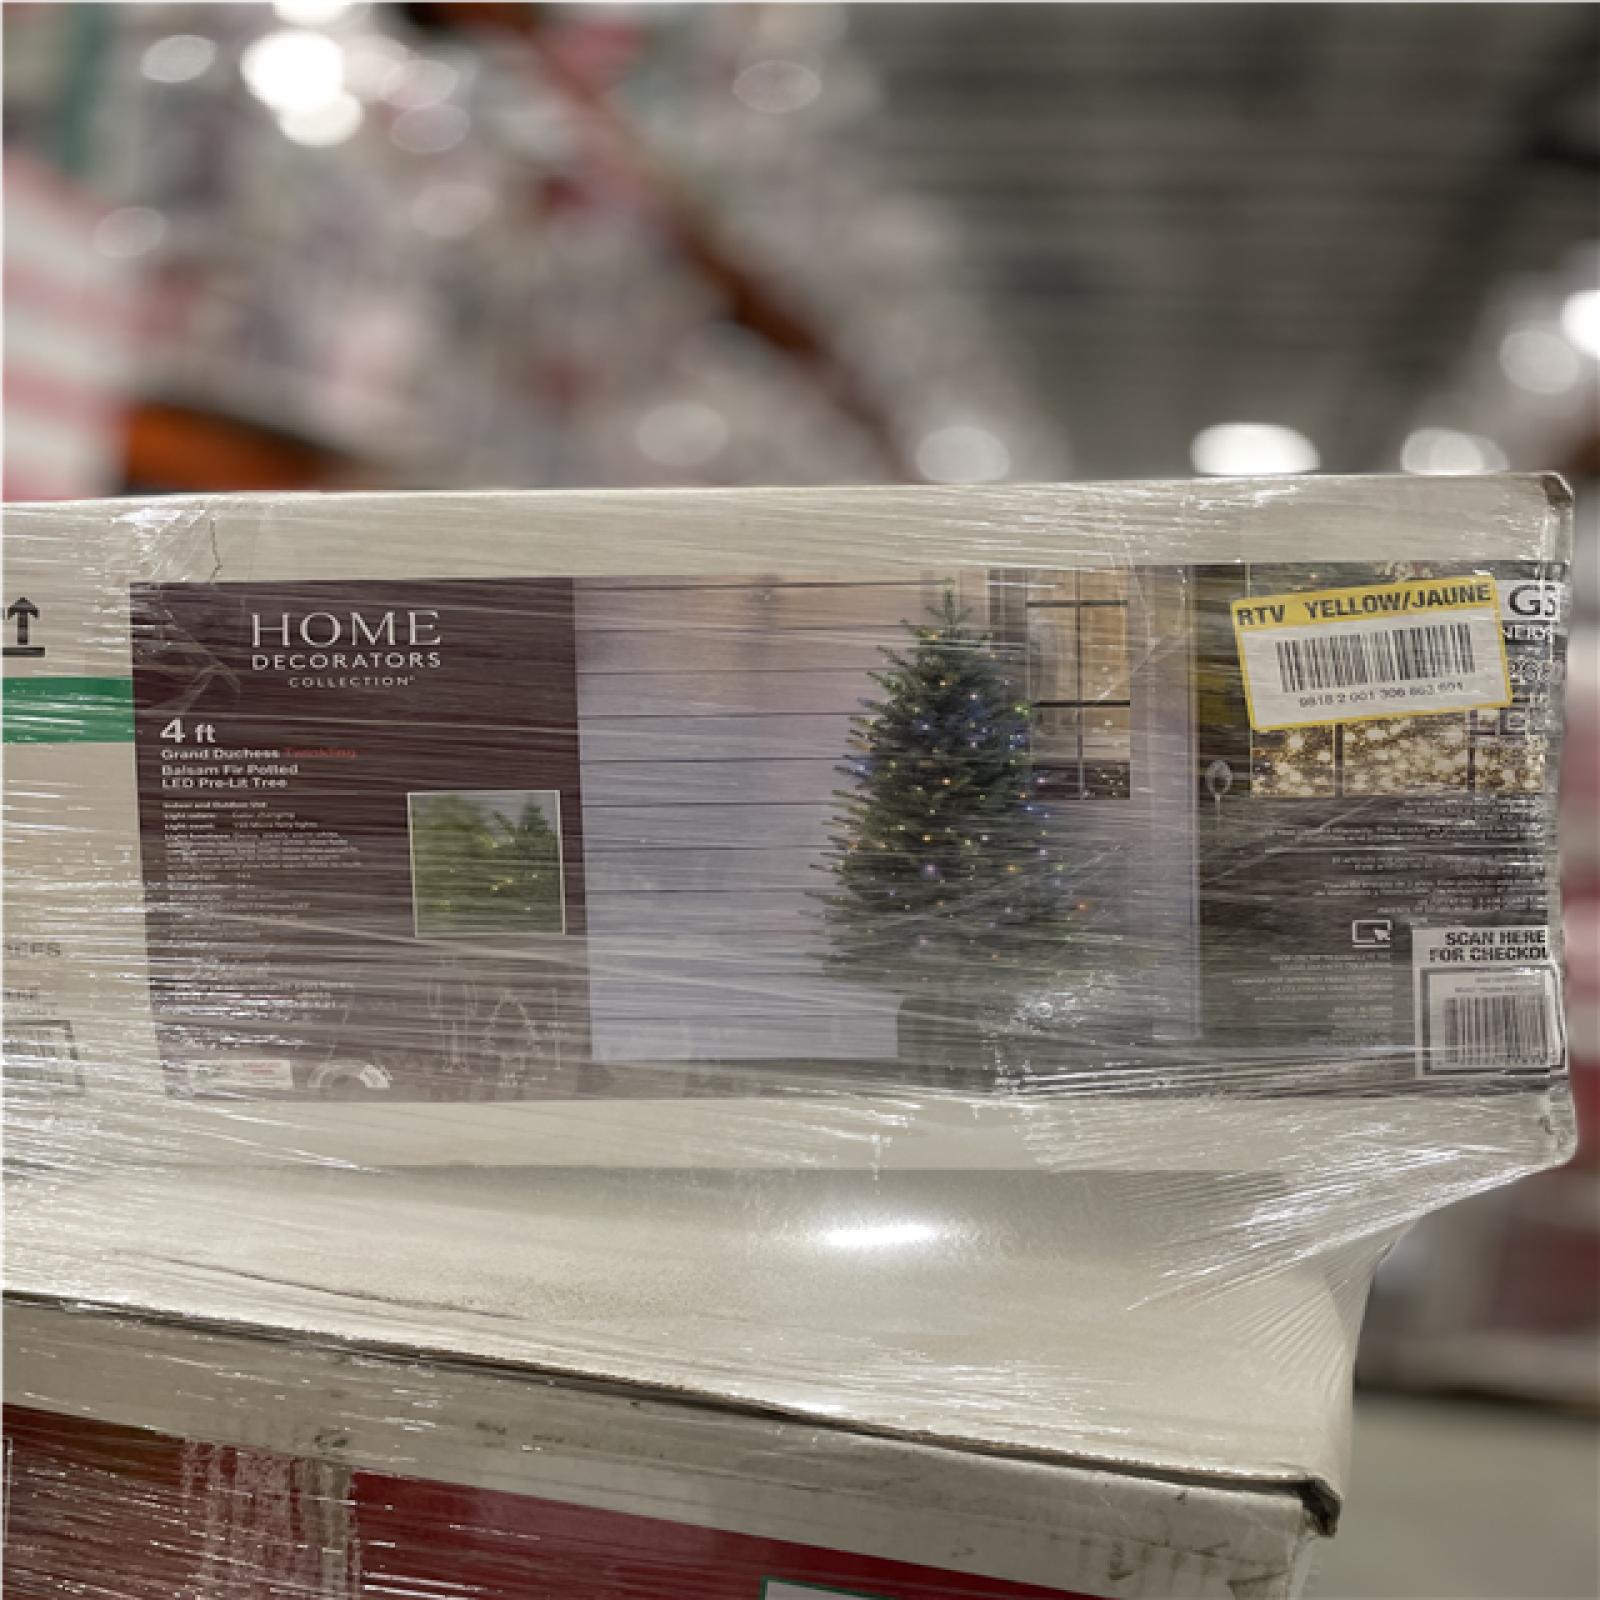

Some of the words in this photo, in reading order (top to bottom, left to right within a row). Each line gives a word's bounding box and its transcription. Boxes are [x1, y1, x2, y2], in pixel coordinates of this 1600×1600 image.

[1237, 604, 1285, 626] RTV
[1303, 584, 1492, 619] YELLOW/JAUNE
[252, 611, 441, 648] HOME
[251, 652, 441, 671] DECORATORS
[160, 717, 186, 743] 4
[195, 724, 216, 743] ft
[161, 749, 208, 760] Grand
[214, 748, 280, 759] Duchess
[162, 764, 220, 776] Balsam
[223, 764, 244, 775] Fir
[247, 764, 299, 776] Potted
[162, 777, 194, 788] LED
[200, 777, 248, 788] Pre-Lit
[252, 777, 288, 788] Tree
[1445, 932, 1494, 946] SCAN
[1499, 930, 1546, 944] HERE
[1429, 947, 1464, 961] FOR
